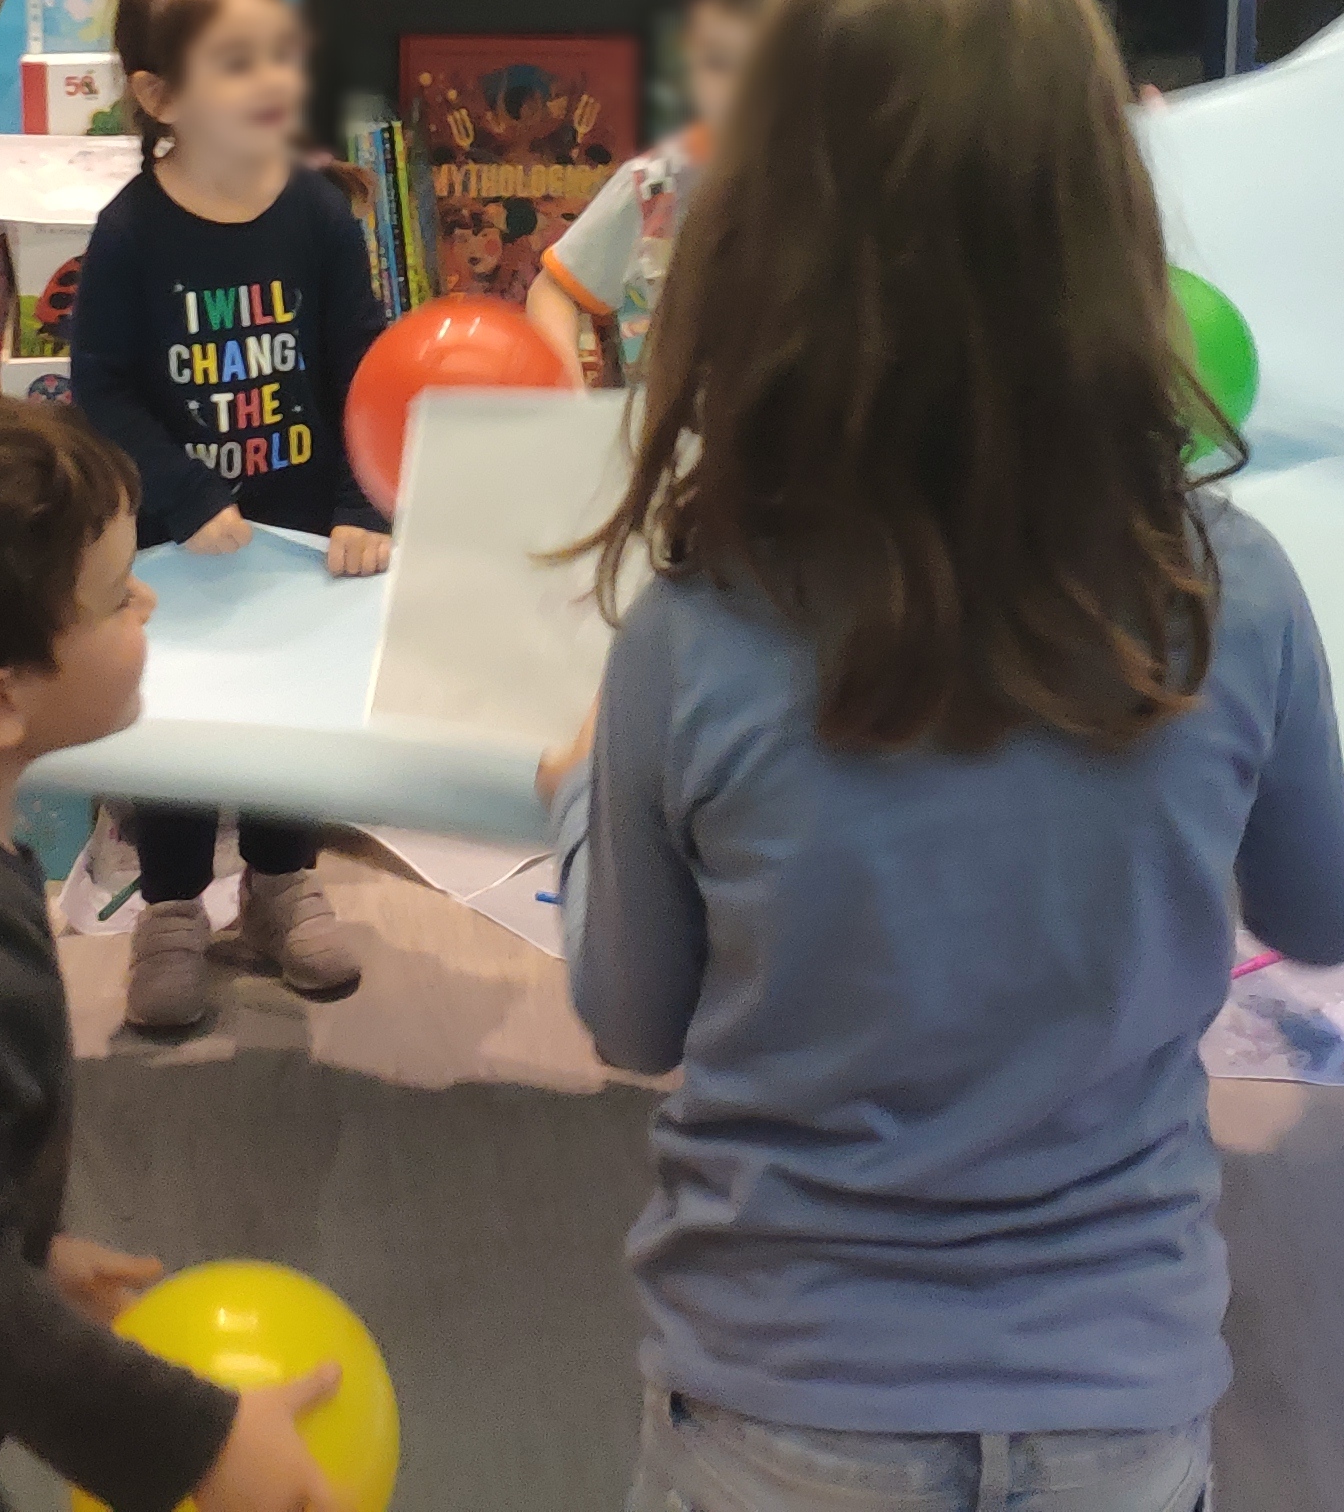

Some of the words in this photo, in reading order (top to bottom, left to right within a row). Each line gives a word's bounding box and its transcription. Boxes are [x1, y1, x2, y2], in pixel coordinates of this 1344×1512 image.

[185, 290, 199, 334] I
[203, 280, 295, 331] WILL
[168, 332, 306, 385] CHANG
[210, 382, 284, 433] THE
